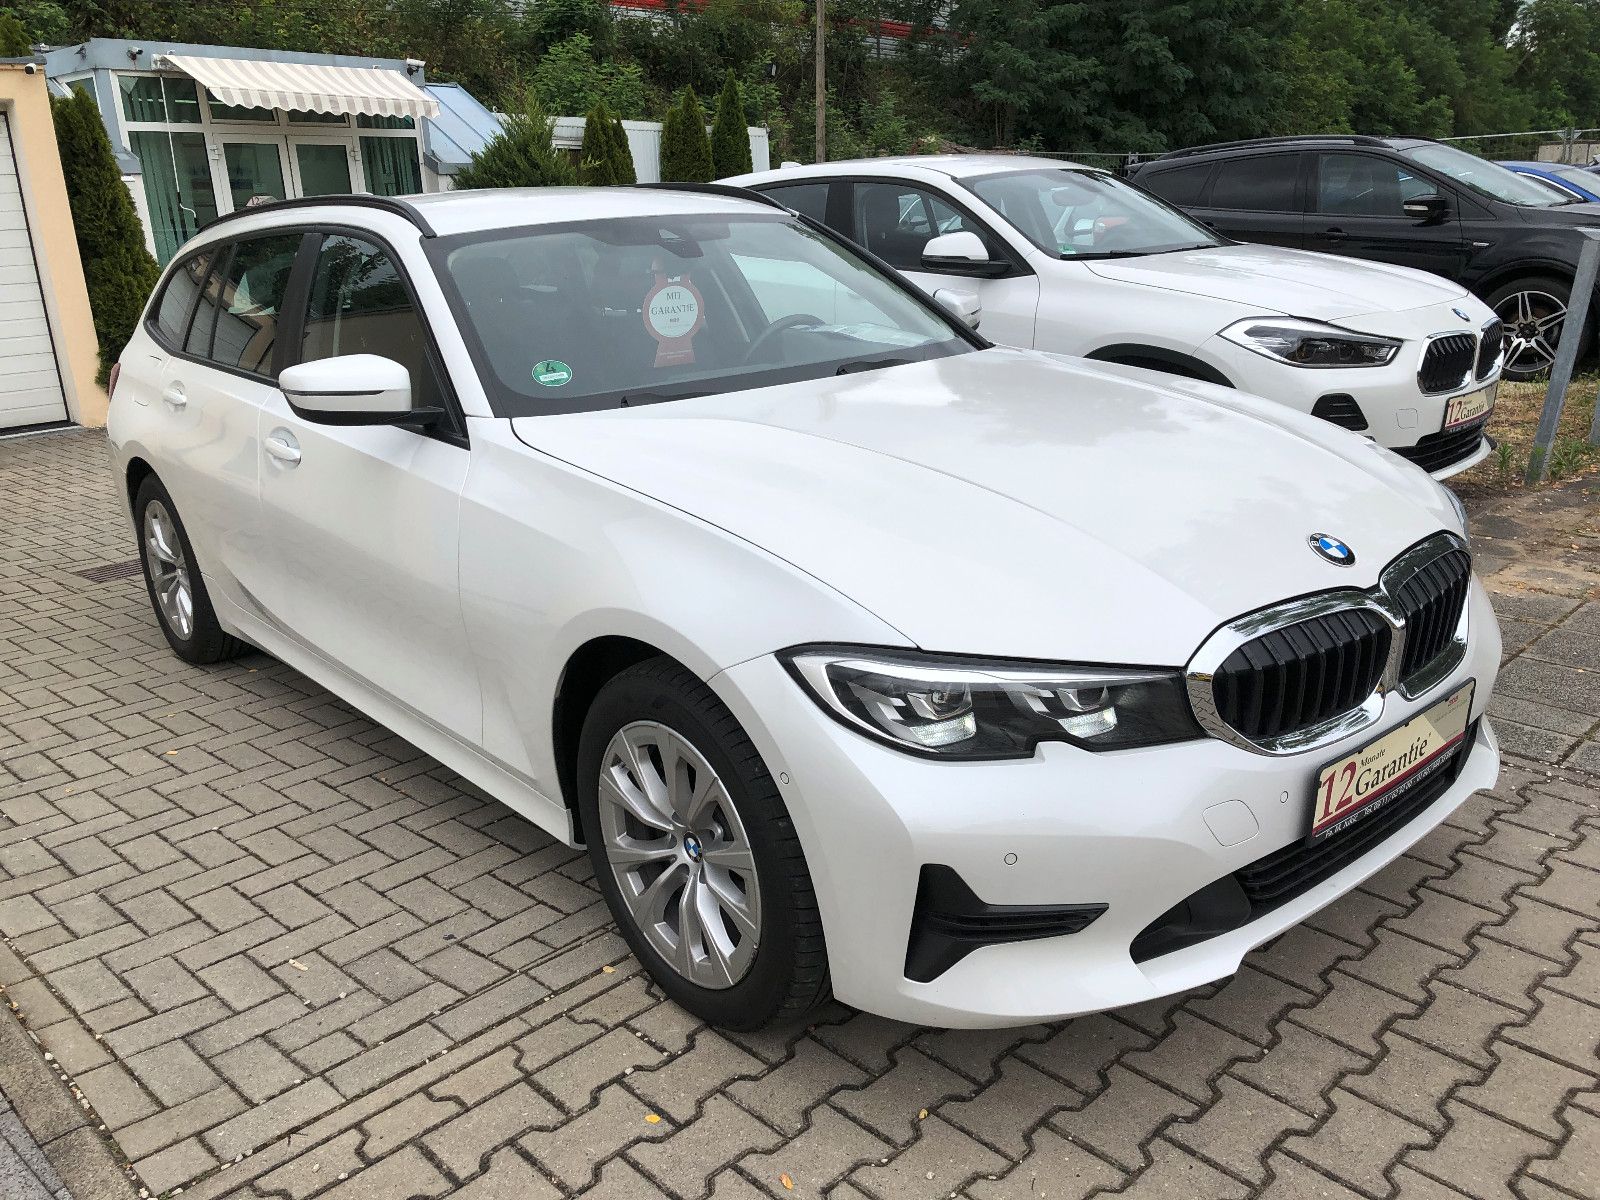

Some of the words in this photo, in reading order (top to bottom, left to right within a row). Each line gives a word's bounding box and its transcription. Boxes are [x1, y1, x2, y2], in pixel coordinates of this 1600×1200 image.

[666, 291, 681, 300] MIT
[651, 303, 695, 315] GARANTIE
[1447, 400, 1463, 425] 12
[1360, 748, 1386, 769] Monate
[1317, 761, 1357, 822] 12
